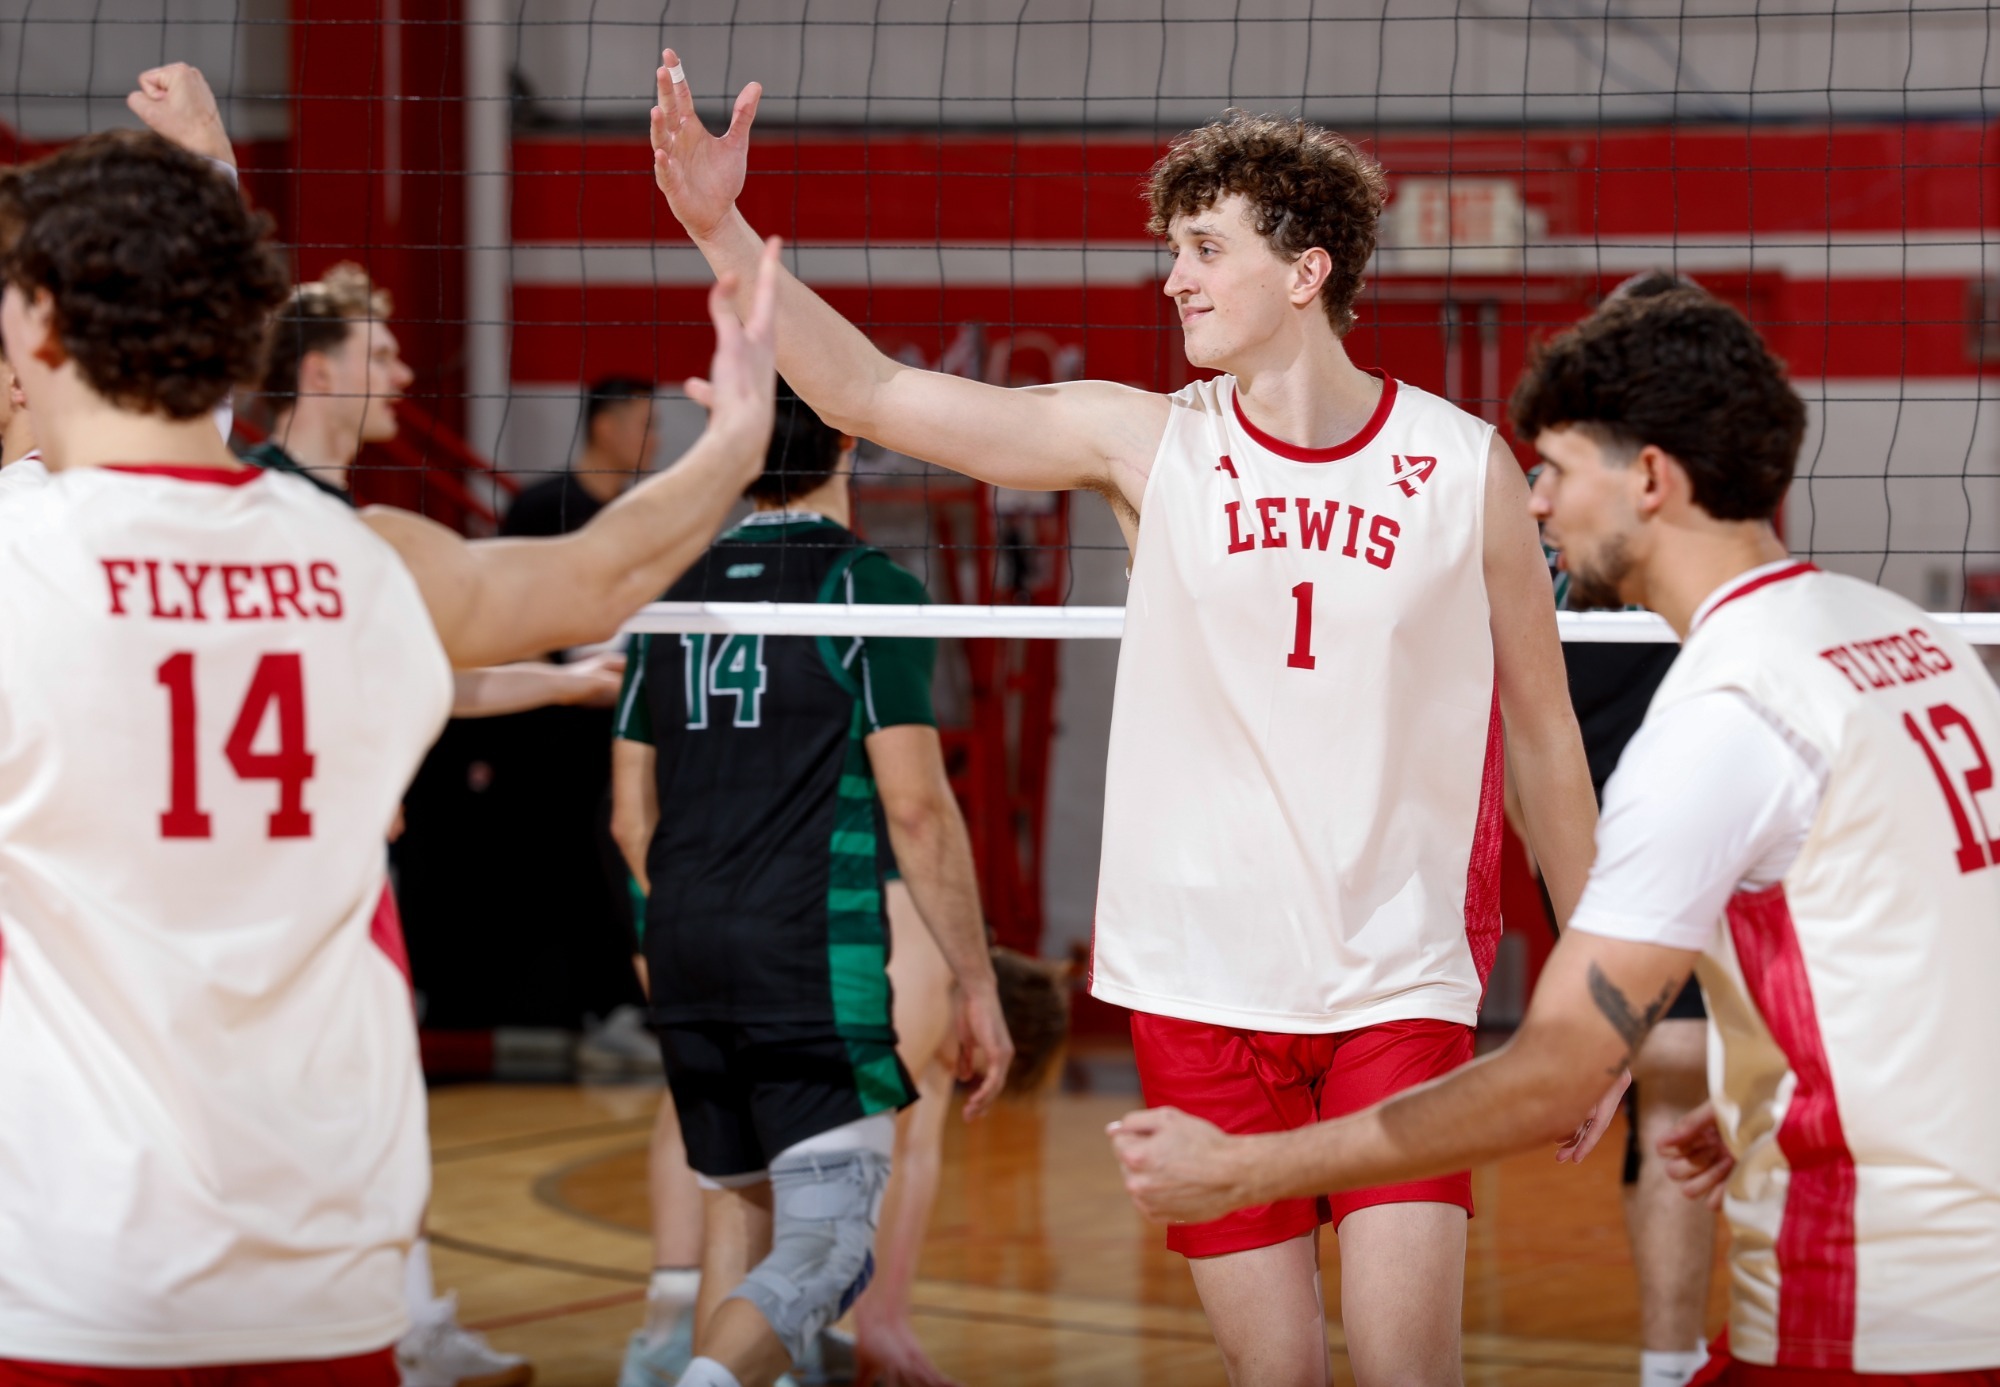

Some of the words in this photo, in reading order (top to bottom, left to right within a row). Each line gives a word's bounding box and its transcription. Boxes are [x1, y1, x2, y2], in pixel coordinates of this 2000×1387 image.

[1224, 497, 1401, 570] LEWIS
[99, 558, 344, 621] FLYERS
[1287, 581, 1316, 670] 1
[680, 633, 767, 730] 14
[1818, 626, 1954, 693] FLYERS
[156, 652, 316, 839] 14
[1902, 703, 2000, 874] 12
